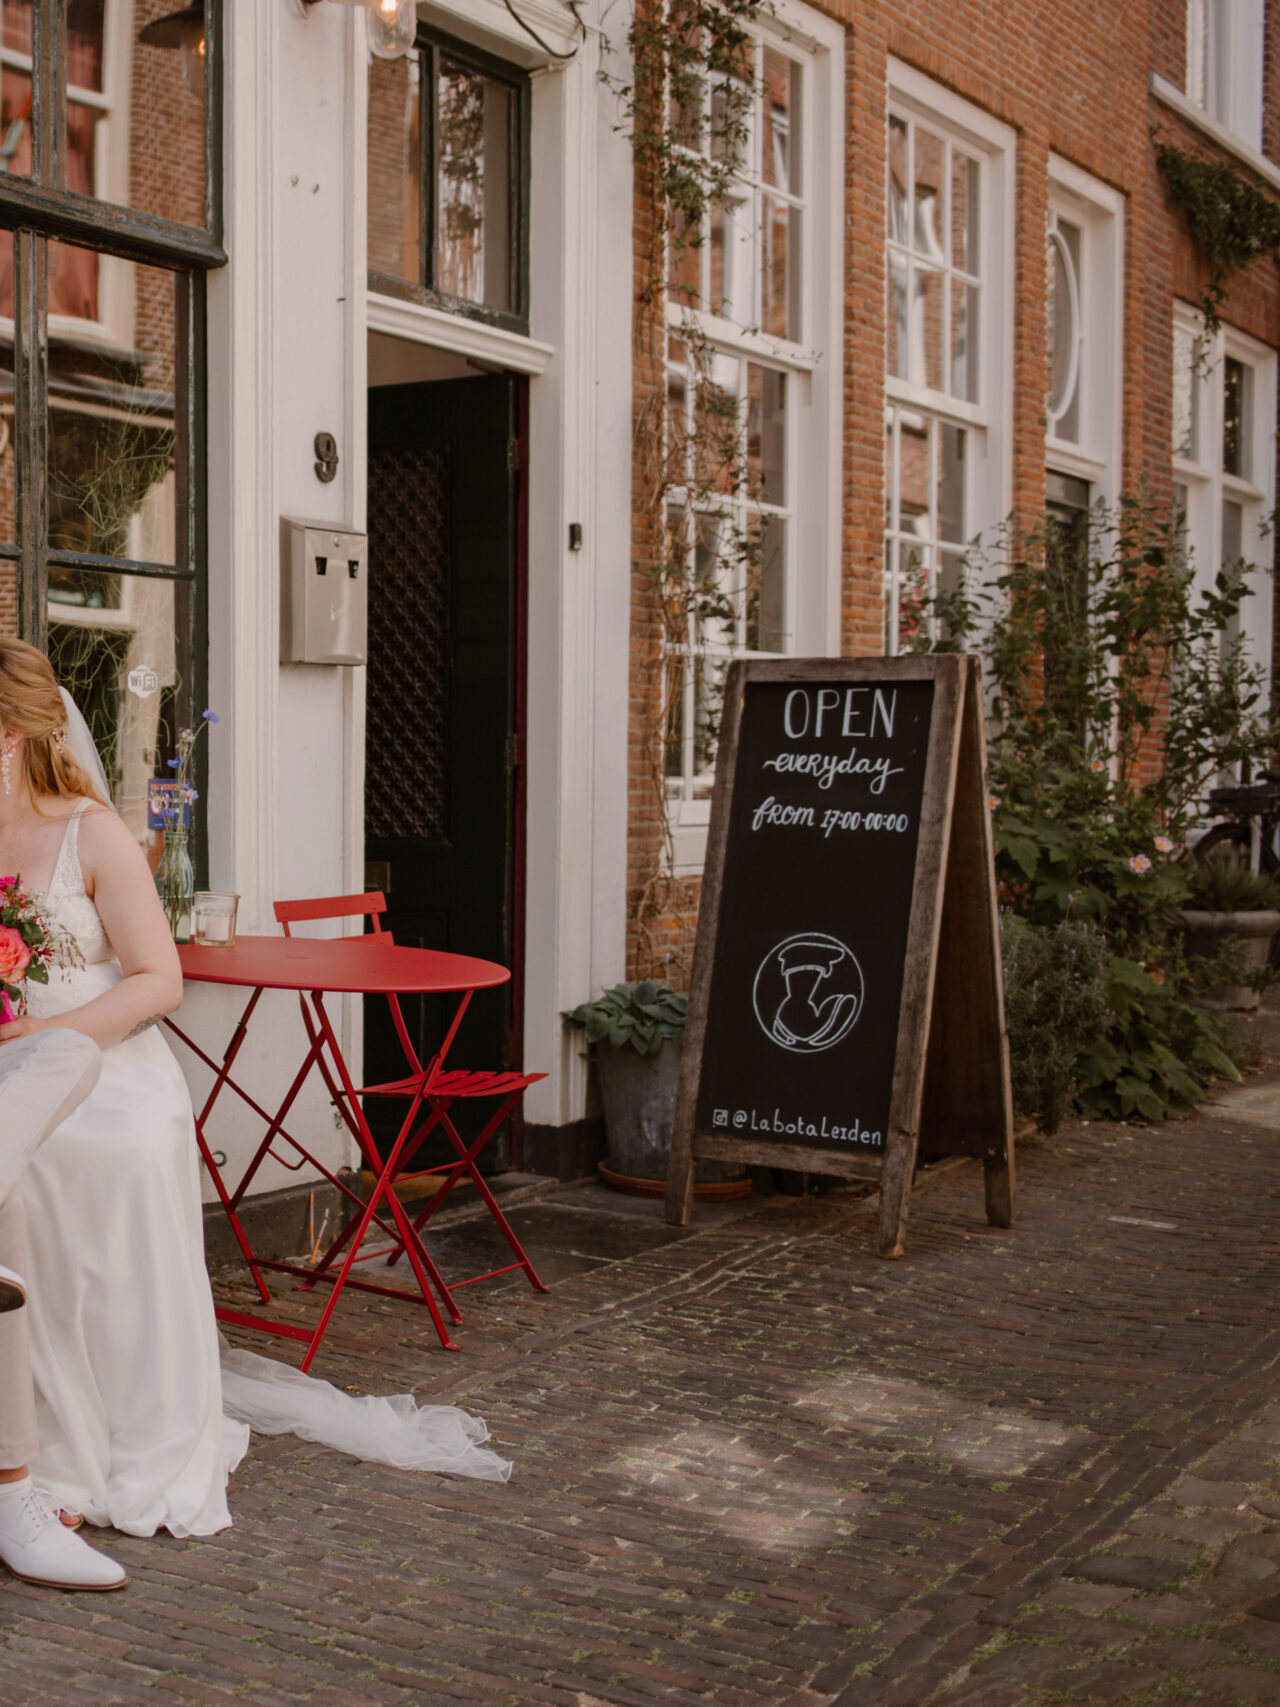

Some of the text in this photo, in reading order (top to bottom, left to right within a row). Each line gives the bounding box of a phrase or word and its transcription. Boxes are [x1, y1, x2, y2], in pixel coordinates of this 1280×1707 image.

[313, 431, 339, 484] 9
[784, 688, 897, 739] OPEN
[762, 747, 904, 795] everyday
[751, 796, 815, 831] from
